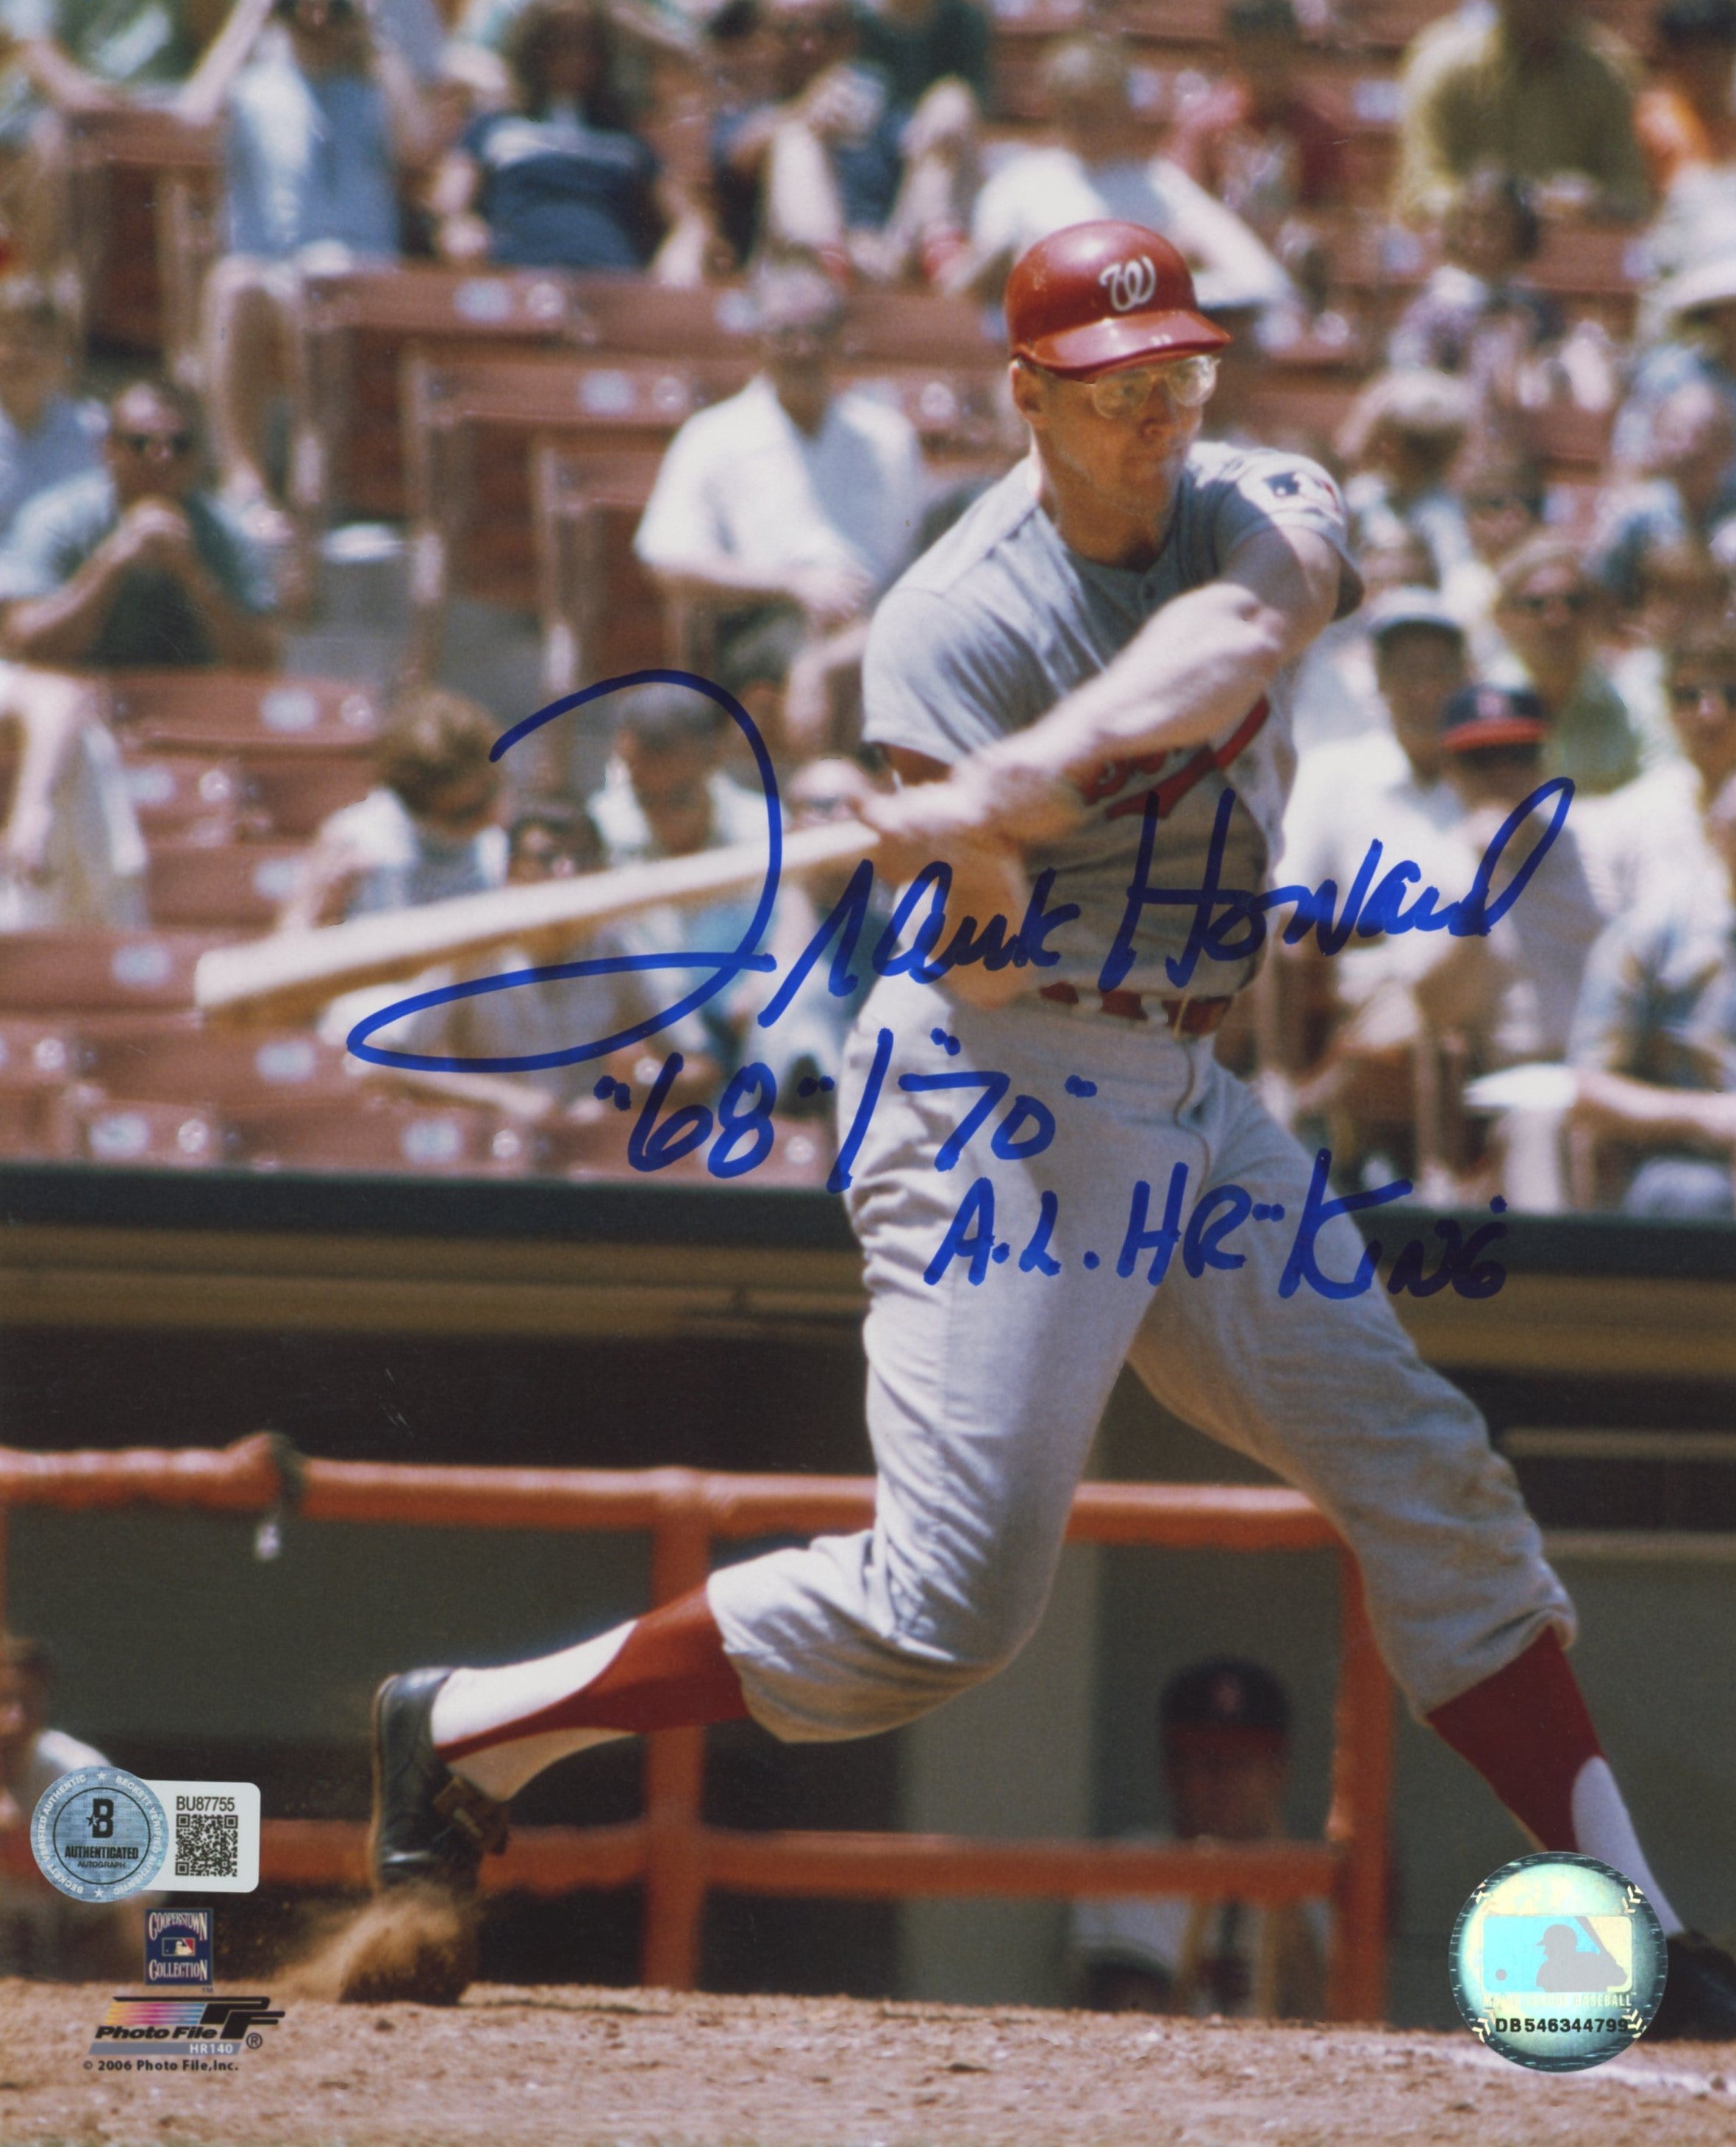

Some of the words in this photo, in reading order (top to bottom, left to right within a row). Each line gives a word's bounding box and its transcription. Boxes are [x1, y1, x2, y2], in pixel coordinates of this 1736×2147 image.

[1099, 255, 1156, 312] W
[176, 1796, 235, 1812] BU87755
[65, 1846, 139, 1860] AUTHENTICATED
[1574, 1993, 1632, 2007] BASEBALL
[1495, 2018, 1629, 2032] DB546344799
